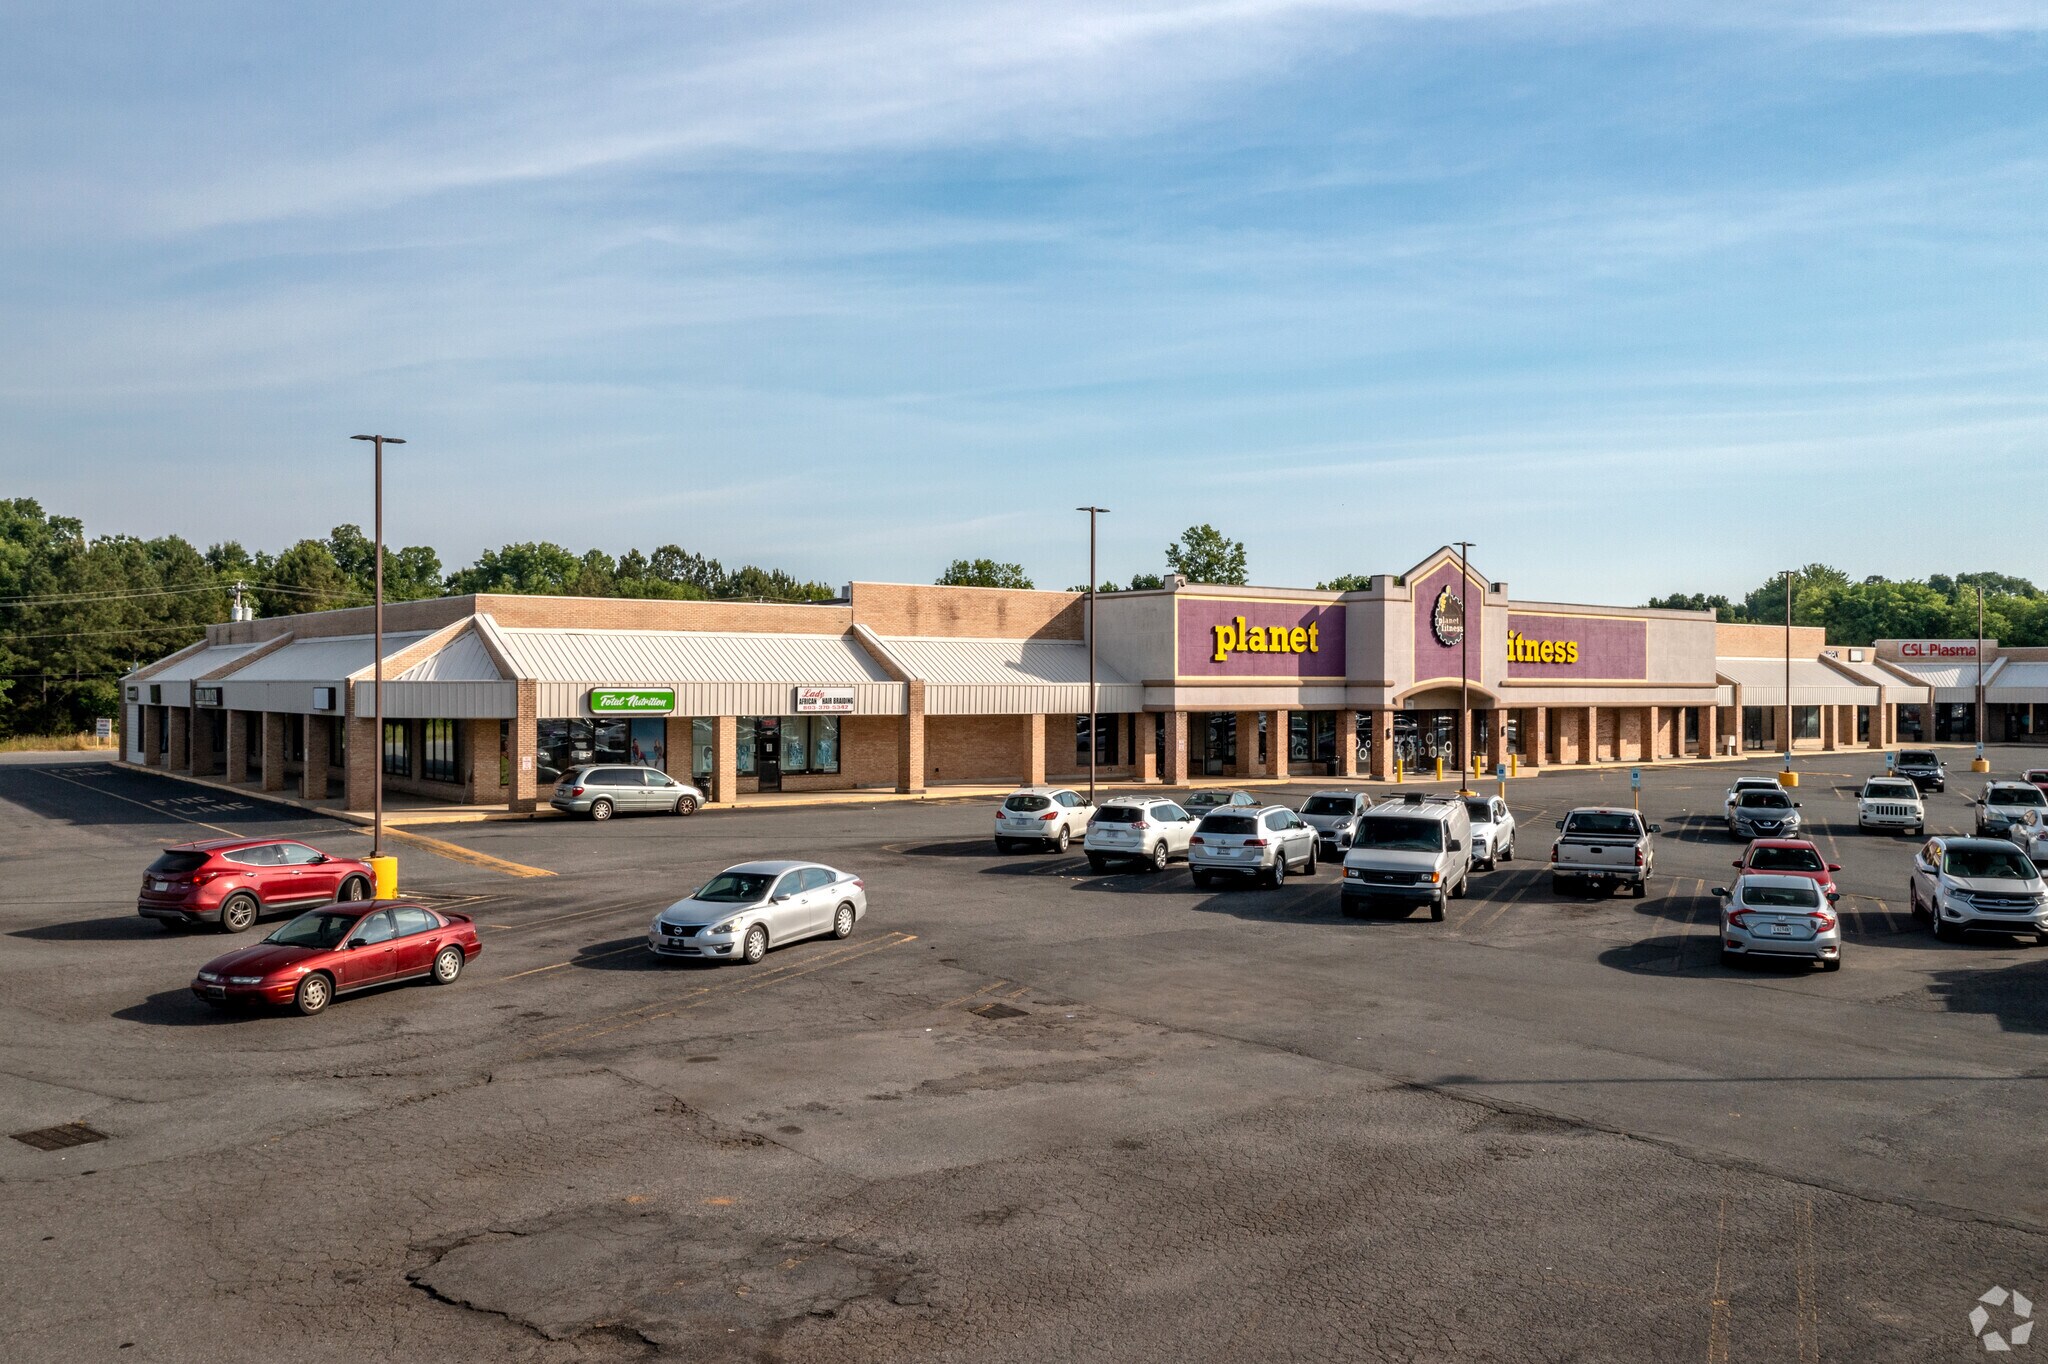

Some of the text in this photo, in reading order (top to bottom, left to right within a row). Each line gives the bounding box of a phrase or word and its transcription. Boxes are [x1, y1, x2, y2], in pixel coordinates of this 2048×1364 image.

[1438, 616, 1459, 626] planet
[1215, 616, 1319, 661] planet
[1507, 630, 1579, 663] itness
[1902, 643, 1977, 656] CSL Plasma
[802, 688, 825, 700] Lady
[600, 694, 667, 708] Total Nutrition
[799, 697, 817, 705] AFRICAN
[152, 796, 216, 806] FIRE
[173, 802, 254, 815] LANE
